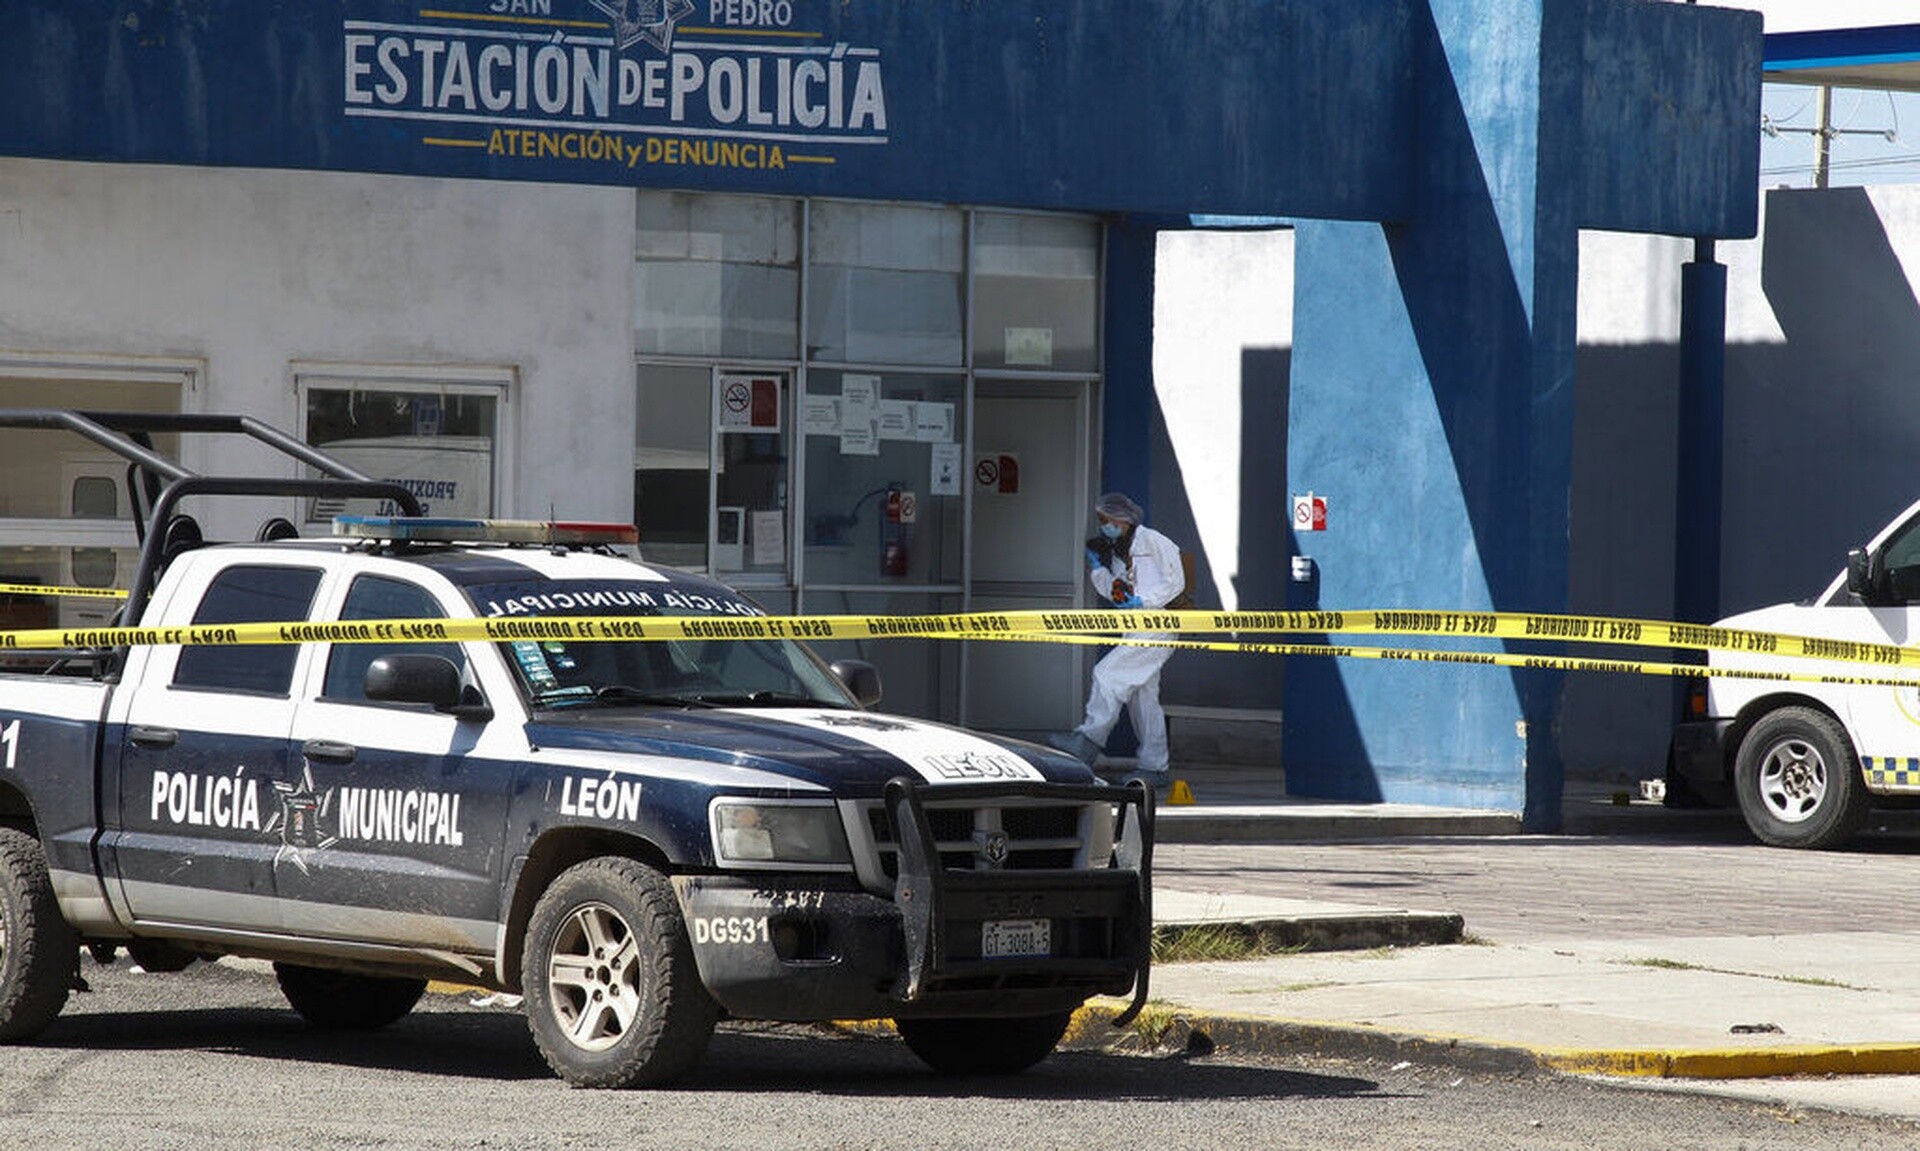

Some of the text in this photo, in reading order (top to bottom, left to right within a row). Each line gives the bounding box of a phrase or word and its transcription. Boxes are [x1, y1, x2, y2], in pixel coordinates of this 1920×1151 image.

[710, 0, 792, 26] PEDRO
[345, 30, 887, 130] ESTACIÓN DE POLICÍA
[487, 129, 622, 161] ATENCIÓN
[646, 138, 785, 169] DENUNCIA
[925, 751, 1030, 779] LEÓN
[151, 765, 463, 846] POLICÍA MUNICIPAL
[559, 774, 643, 822] LEÓN
